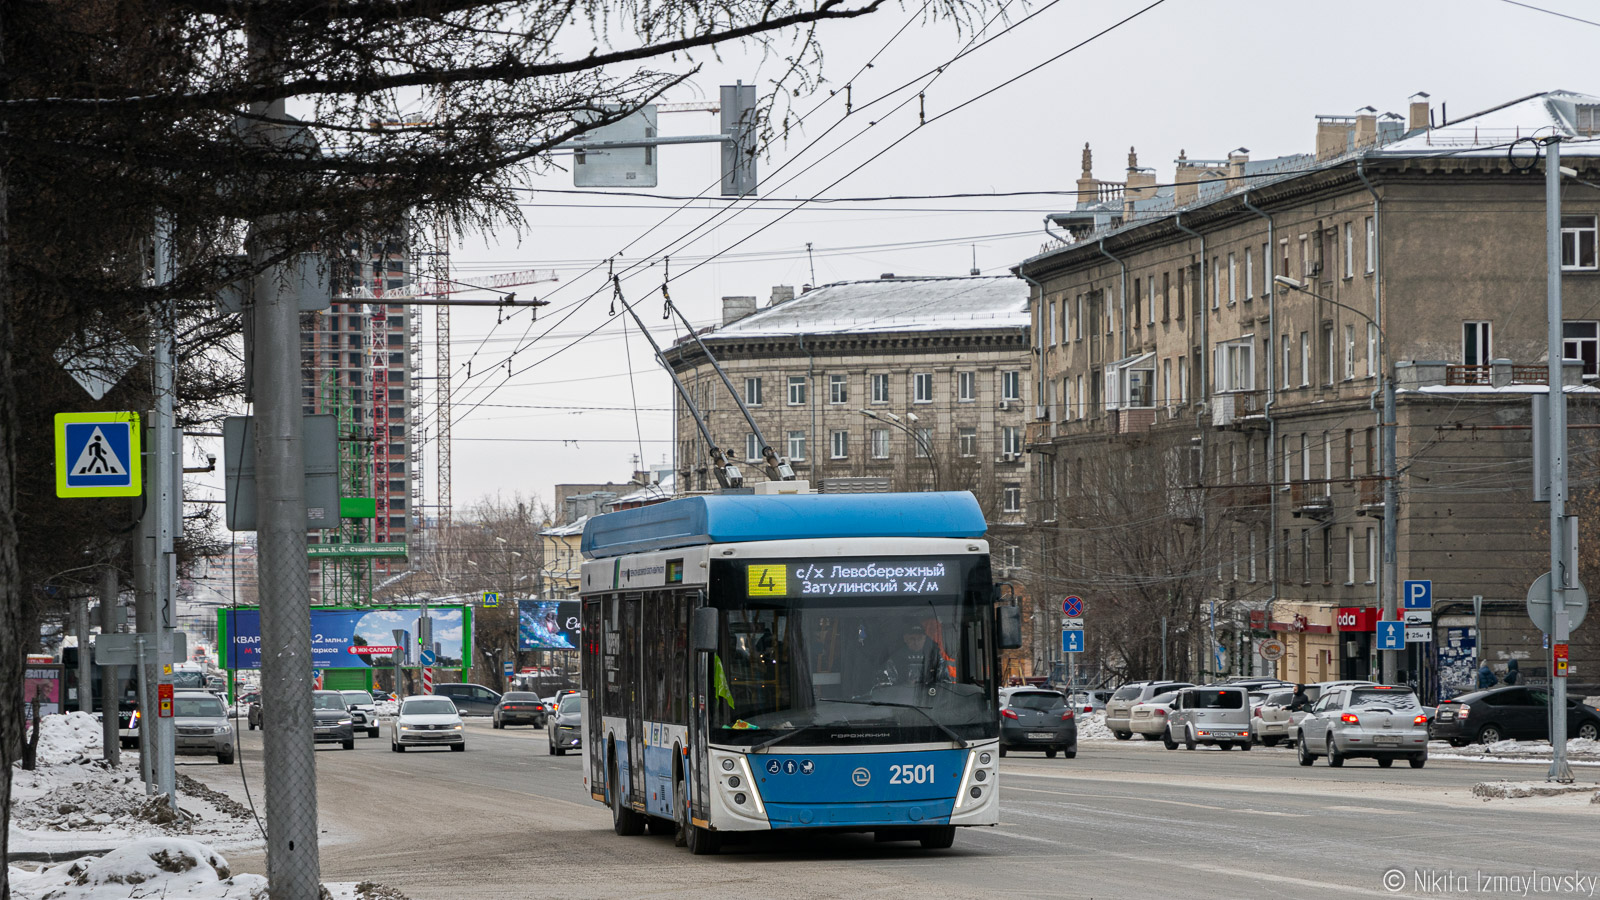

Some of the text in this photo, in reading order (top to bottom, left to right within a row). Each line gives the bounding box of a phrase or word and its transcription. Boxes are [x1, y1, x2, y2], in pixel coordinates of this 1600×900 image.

[363, 390, 374, 401] 15
[363, 408, 374, 419] 14
[757, 568, 776, 591] 4
[796, 563, 945, 580] с/х Левобережный
[802, 577, 939, 595] Затулинский ж/м
[1411, 583, 1426, 606] P
[310, 634, 324, 644] ,2
[1411, 631, 1424, 639] 25м
[889, 763, 935, 785] 2501
